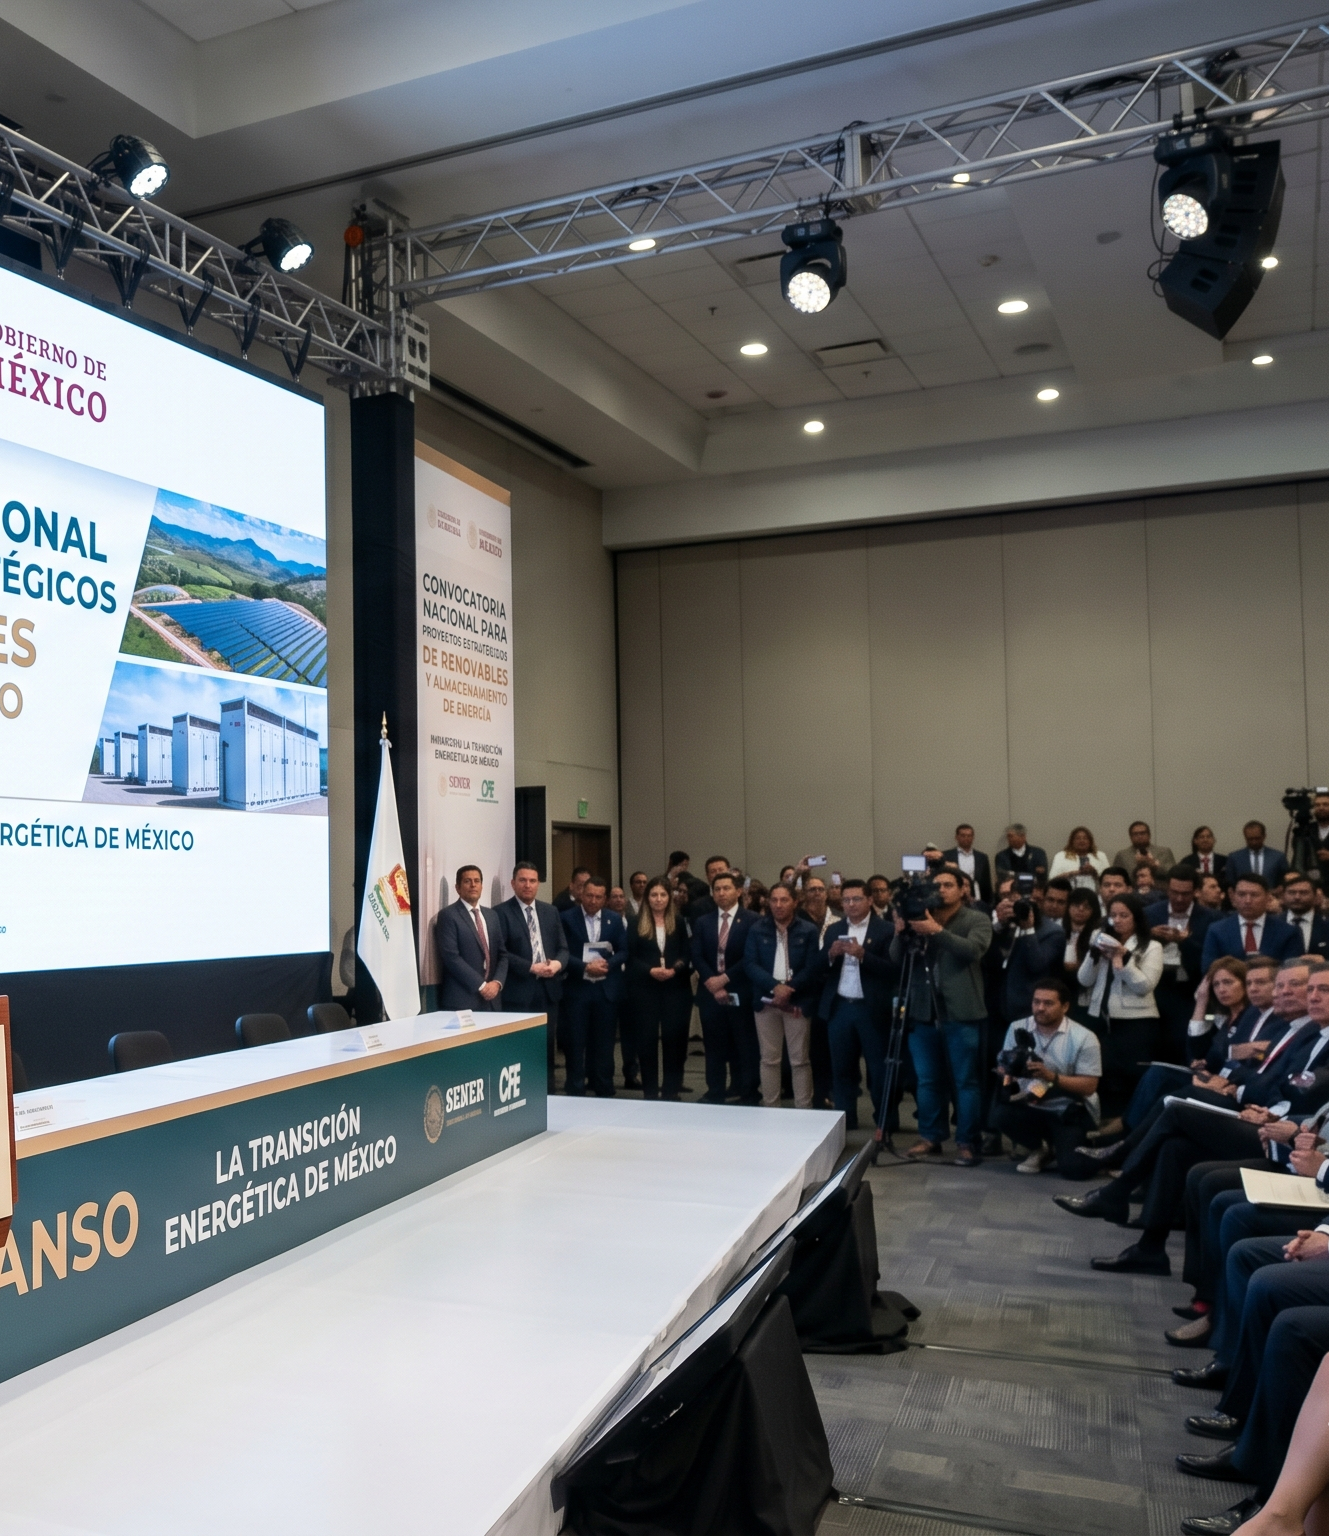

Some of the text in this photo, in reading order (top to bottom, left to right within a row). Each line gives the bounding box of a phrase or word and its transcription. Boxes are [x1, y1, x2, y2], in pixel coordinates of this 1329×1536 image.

[83, 353, 107, 382] DE
[423, 573, 506, 620] CONVOCATORIA
[423, 598, 507, 644] NACIONAL PARA
[423, 645, 508, 686] DE RENOVABLES
[425, 672, 431, 687] Y
[443, 698, 455, 714] DE
[95, 827, 120, 849] DE
[126, 823, 194, 851] MÉXICO
[445, 1078, 484, 1113] SENER
[499, 1062, 521, 1103] CFE
[216, 1103, 361, 1184] LA TRANSICIÓN
[165, 1135, 397, 1256] ENERGÉTICA DE MÉXICO
